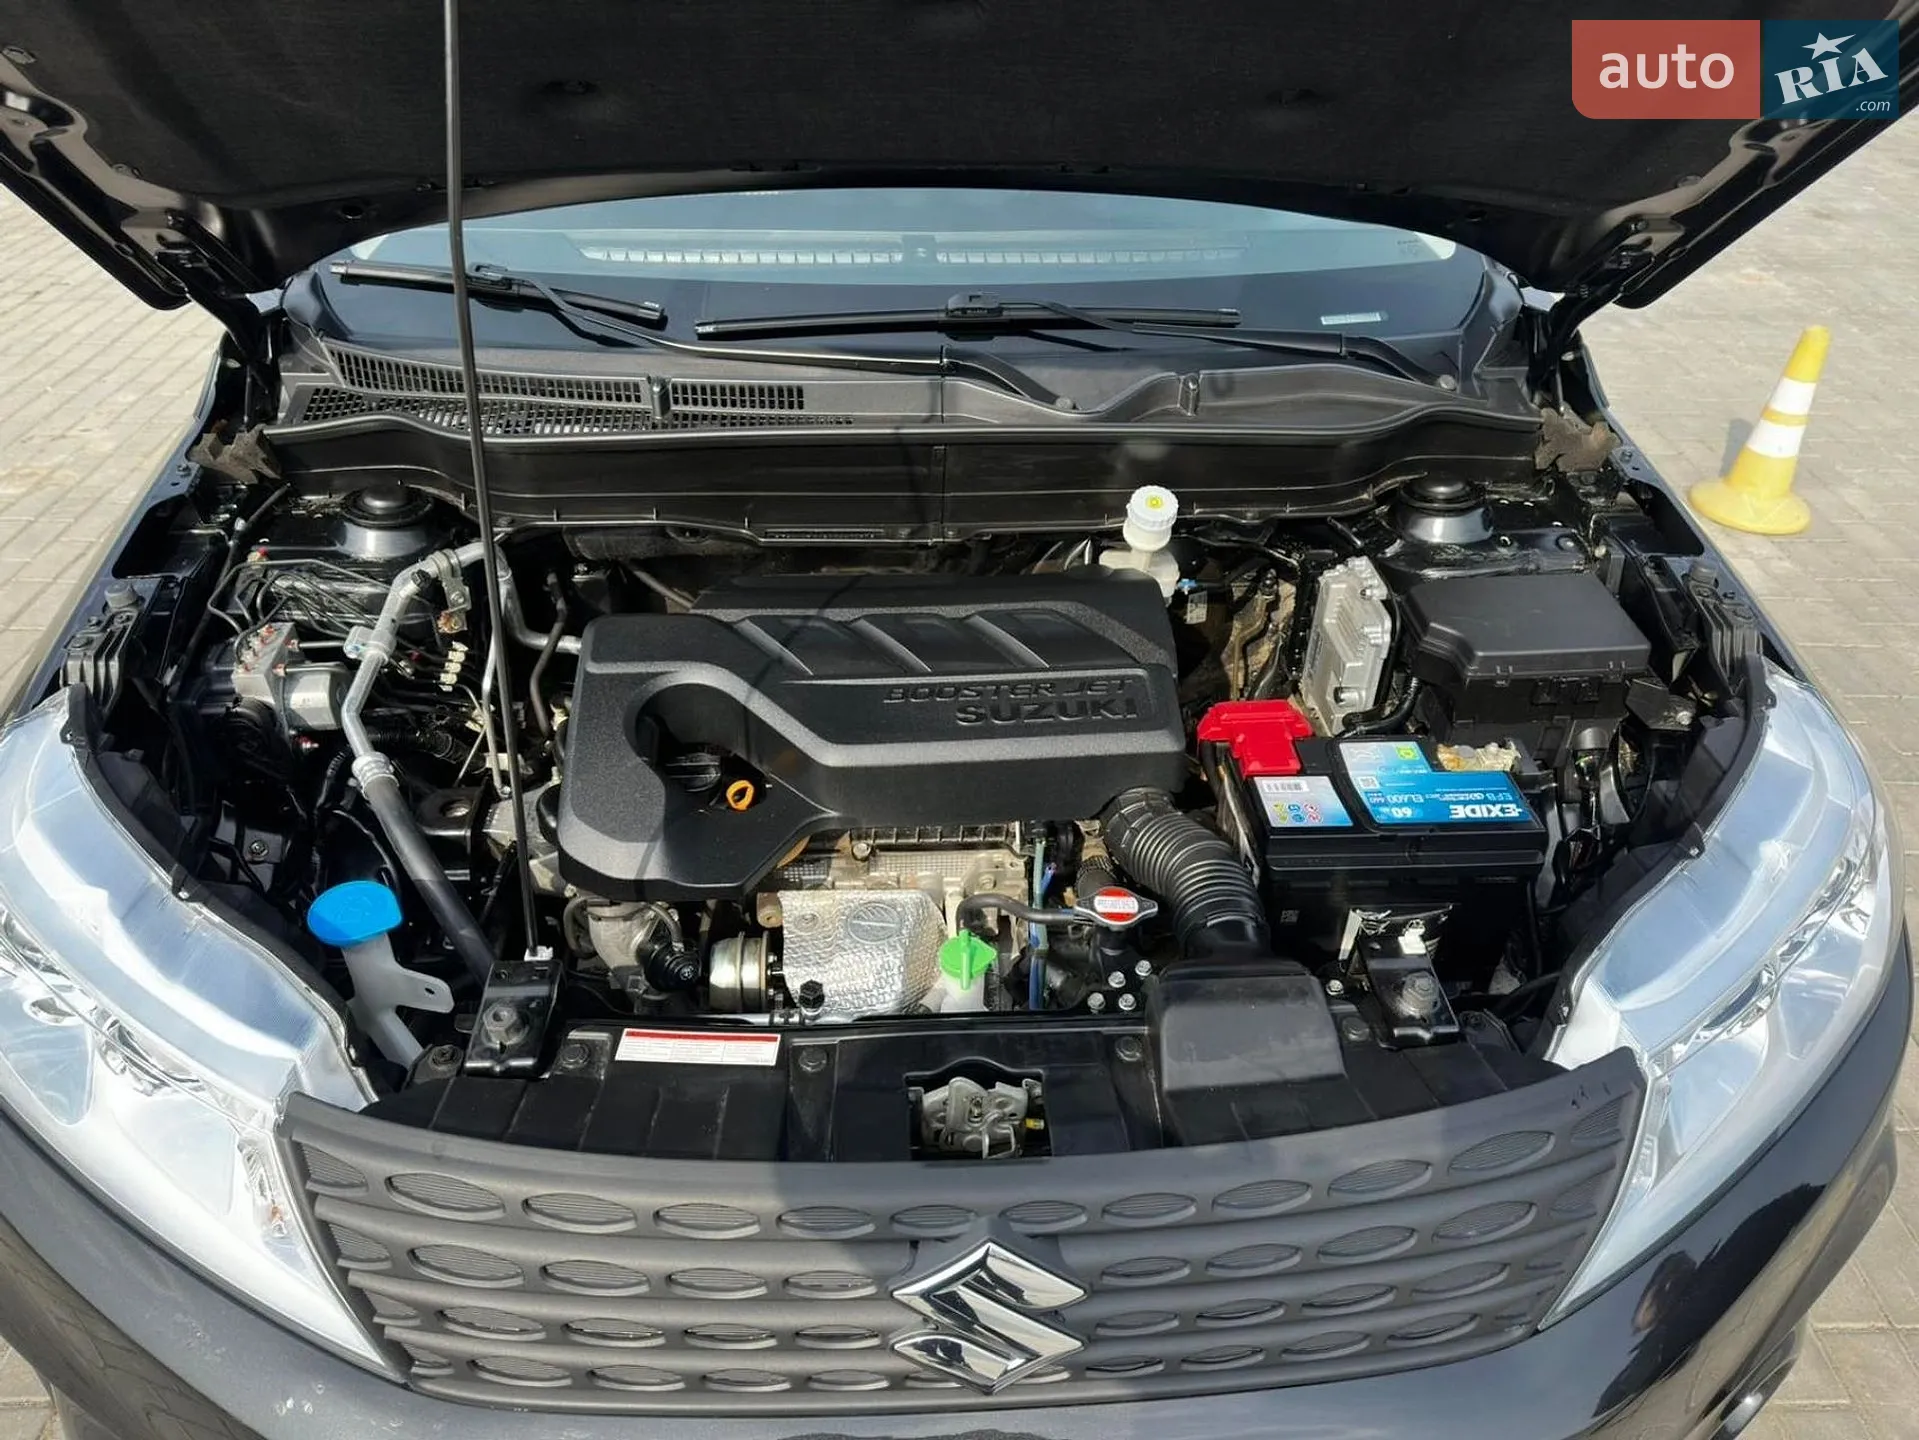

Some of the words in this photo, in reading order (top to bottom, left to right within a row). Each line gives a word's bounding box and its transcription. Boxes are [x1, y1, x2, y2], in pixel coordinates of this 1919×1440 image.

[956, 698, 1138, 726] SUZUKI
[1391, 806, 1413, 818] 60
[1449, 803, 1522, 819] EXIDE
